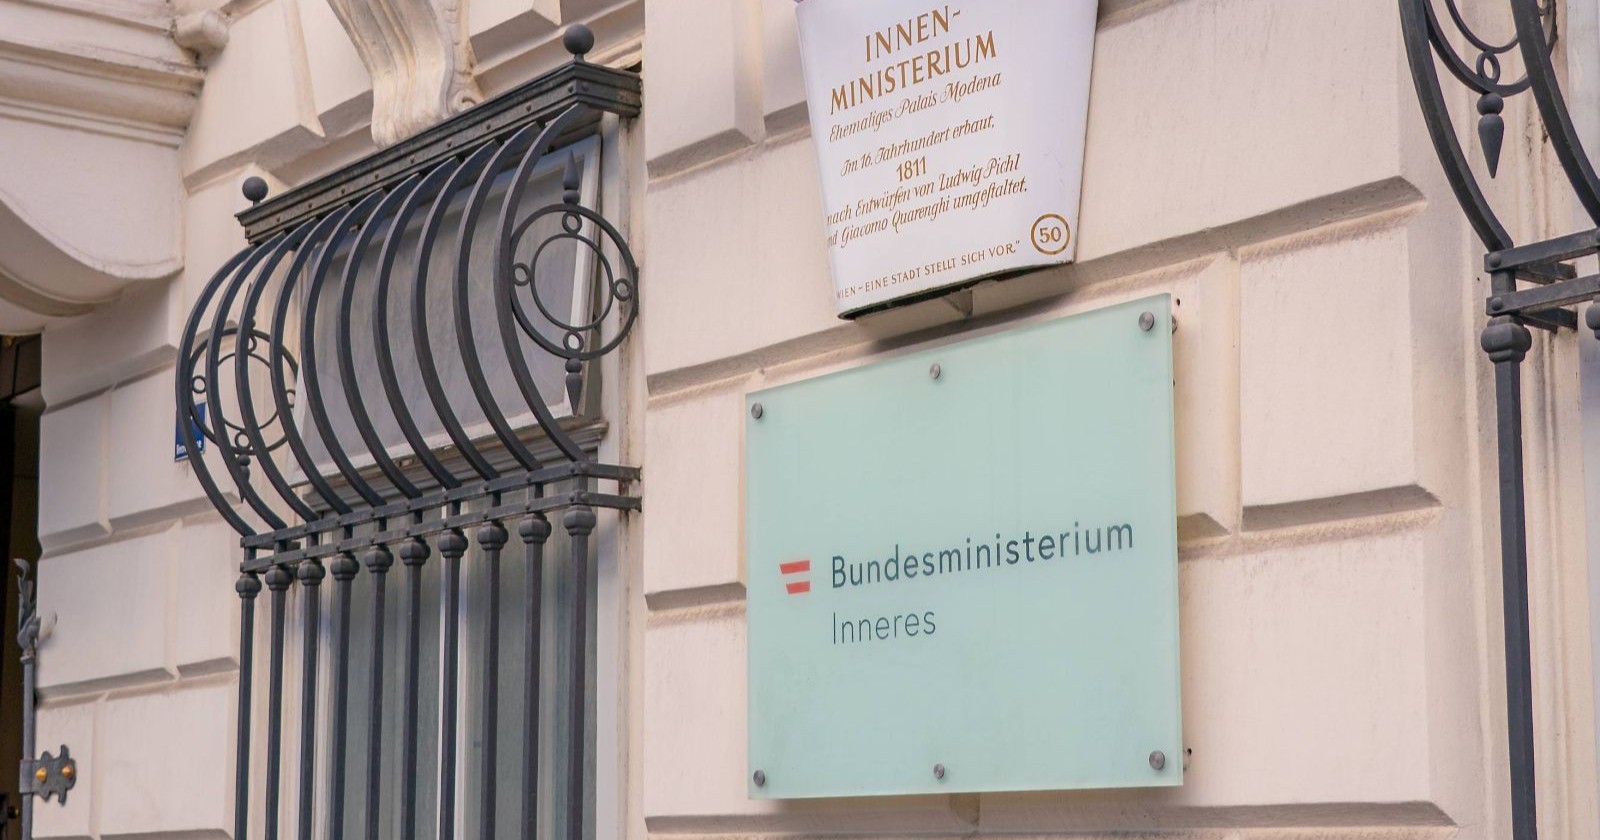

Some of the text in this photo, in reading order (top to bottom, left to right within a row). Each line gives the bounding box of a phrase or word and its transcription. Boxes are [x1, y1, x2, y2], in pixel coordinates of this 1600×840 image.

[865, 5, 961, 62] INNEN-
[830, 30, 997, 115] MINISTERIUM
[829, 72, 1002, 143] Ehemaliges Palais Modena
[861, 153, 873, 168] 16.
[874, 127, 950, 164] Jahrhundert
[896, 156, 927, 181] 1811
[826, 153, 1020, 226] nach Entwürfen von Ludwig Pichl
[840, 217, 888, 249] Giacomo
[892, 194, 950, 234] Quarenghi
[1039, 226, 1062, 244] 50
[865, 276, 889, 293] EINE
[891, 267, 921, 285] STADT
[924, 257, 957, 276] STELLT
[961, 250, 985, 266] SICH
[831, 521, 1134, 589] Bundesministerium
[832, 610, 937, 645] Inneres
